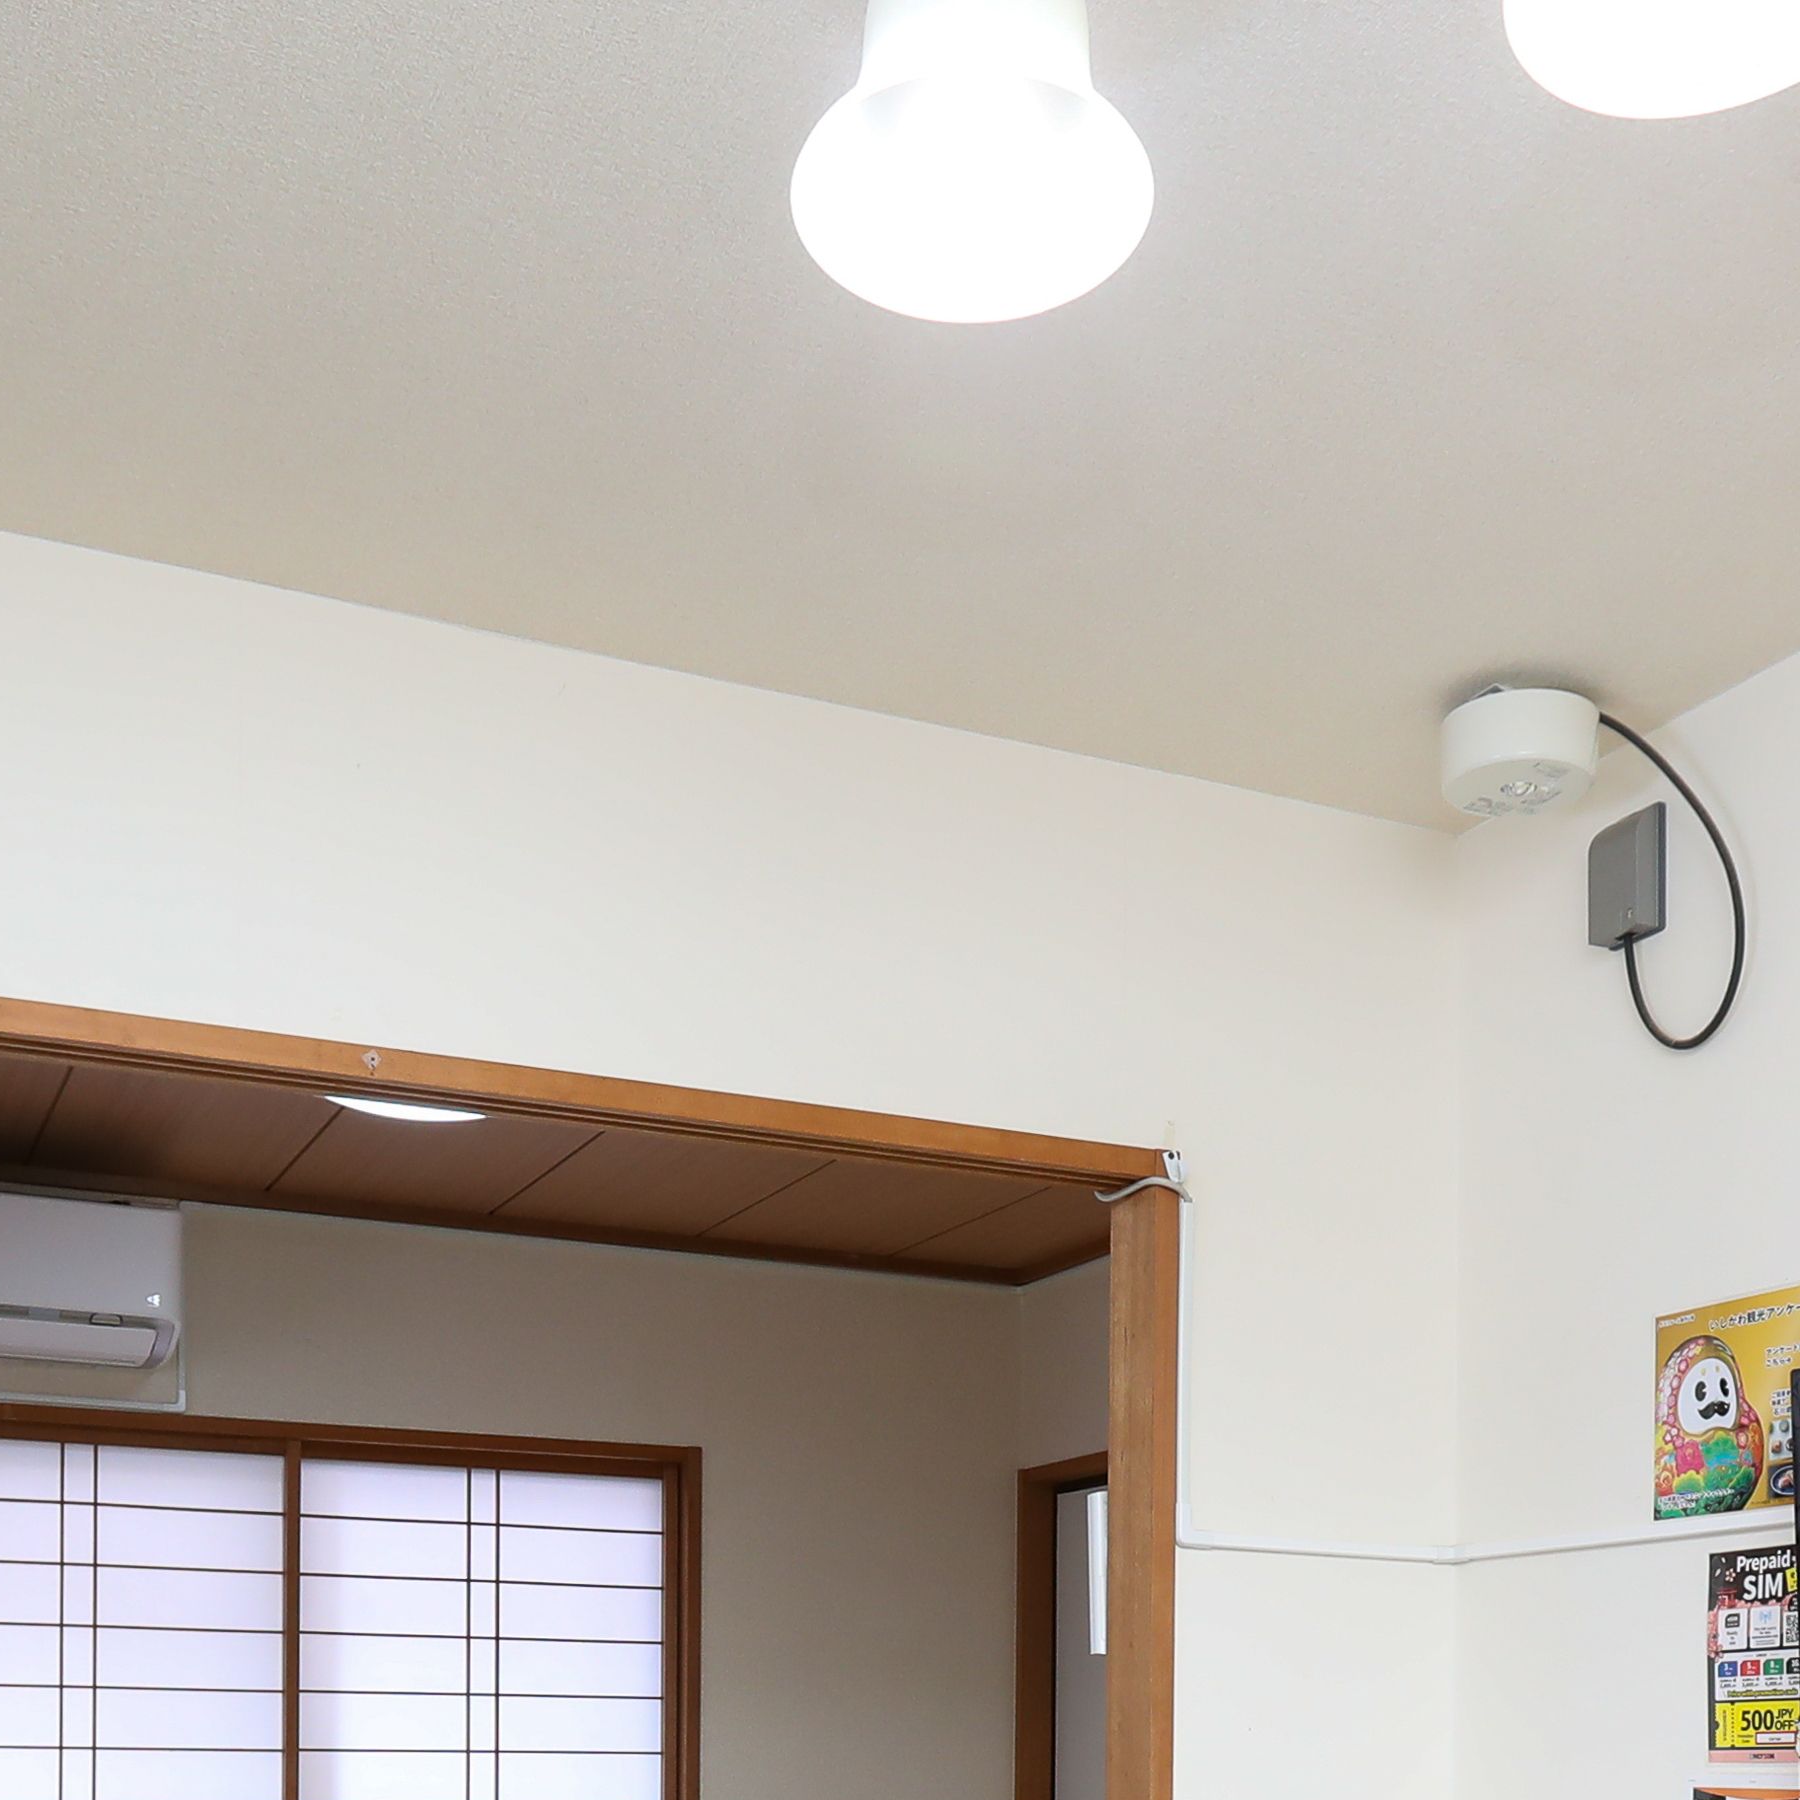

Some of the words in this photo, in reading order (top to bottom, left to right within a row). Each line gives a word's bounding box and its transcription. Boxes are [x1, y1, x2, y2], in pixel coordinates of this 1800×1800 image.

[1736, 1549, 1791, 1573] Prepaid
[1742, 1572, 1784, 1600] SIM
[1740, 1709, 1775, 1732] 500
[1775, 1708, 1794, 1720] JPY
[1774, 1719, 1794, 1731] OFF
